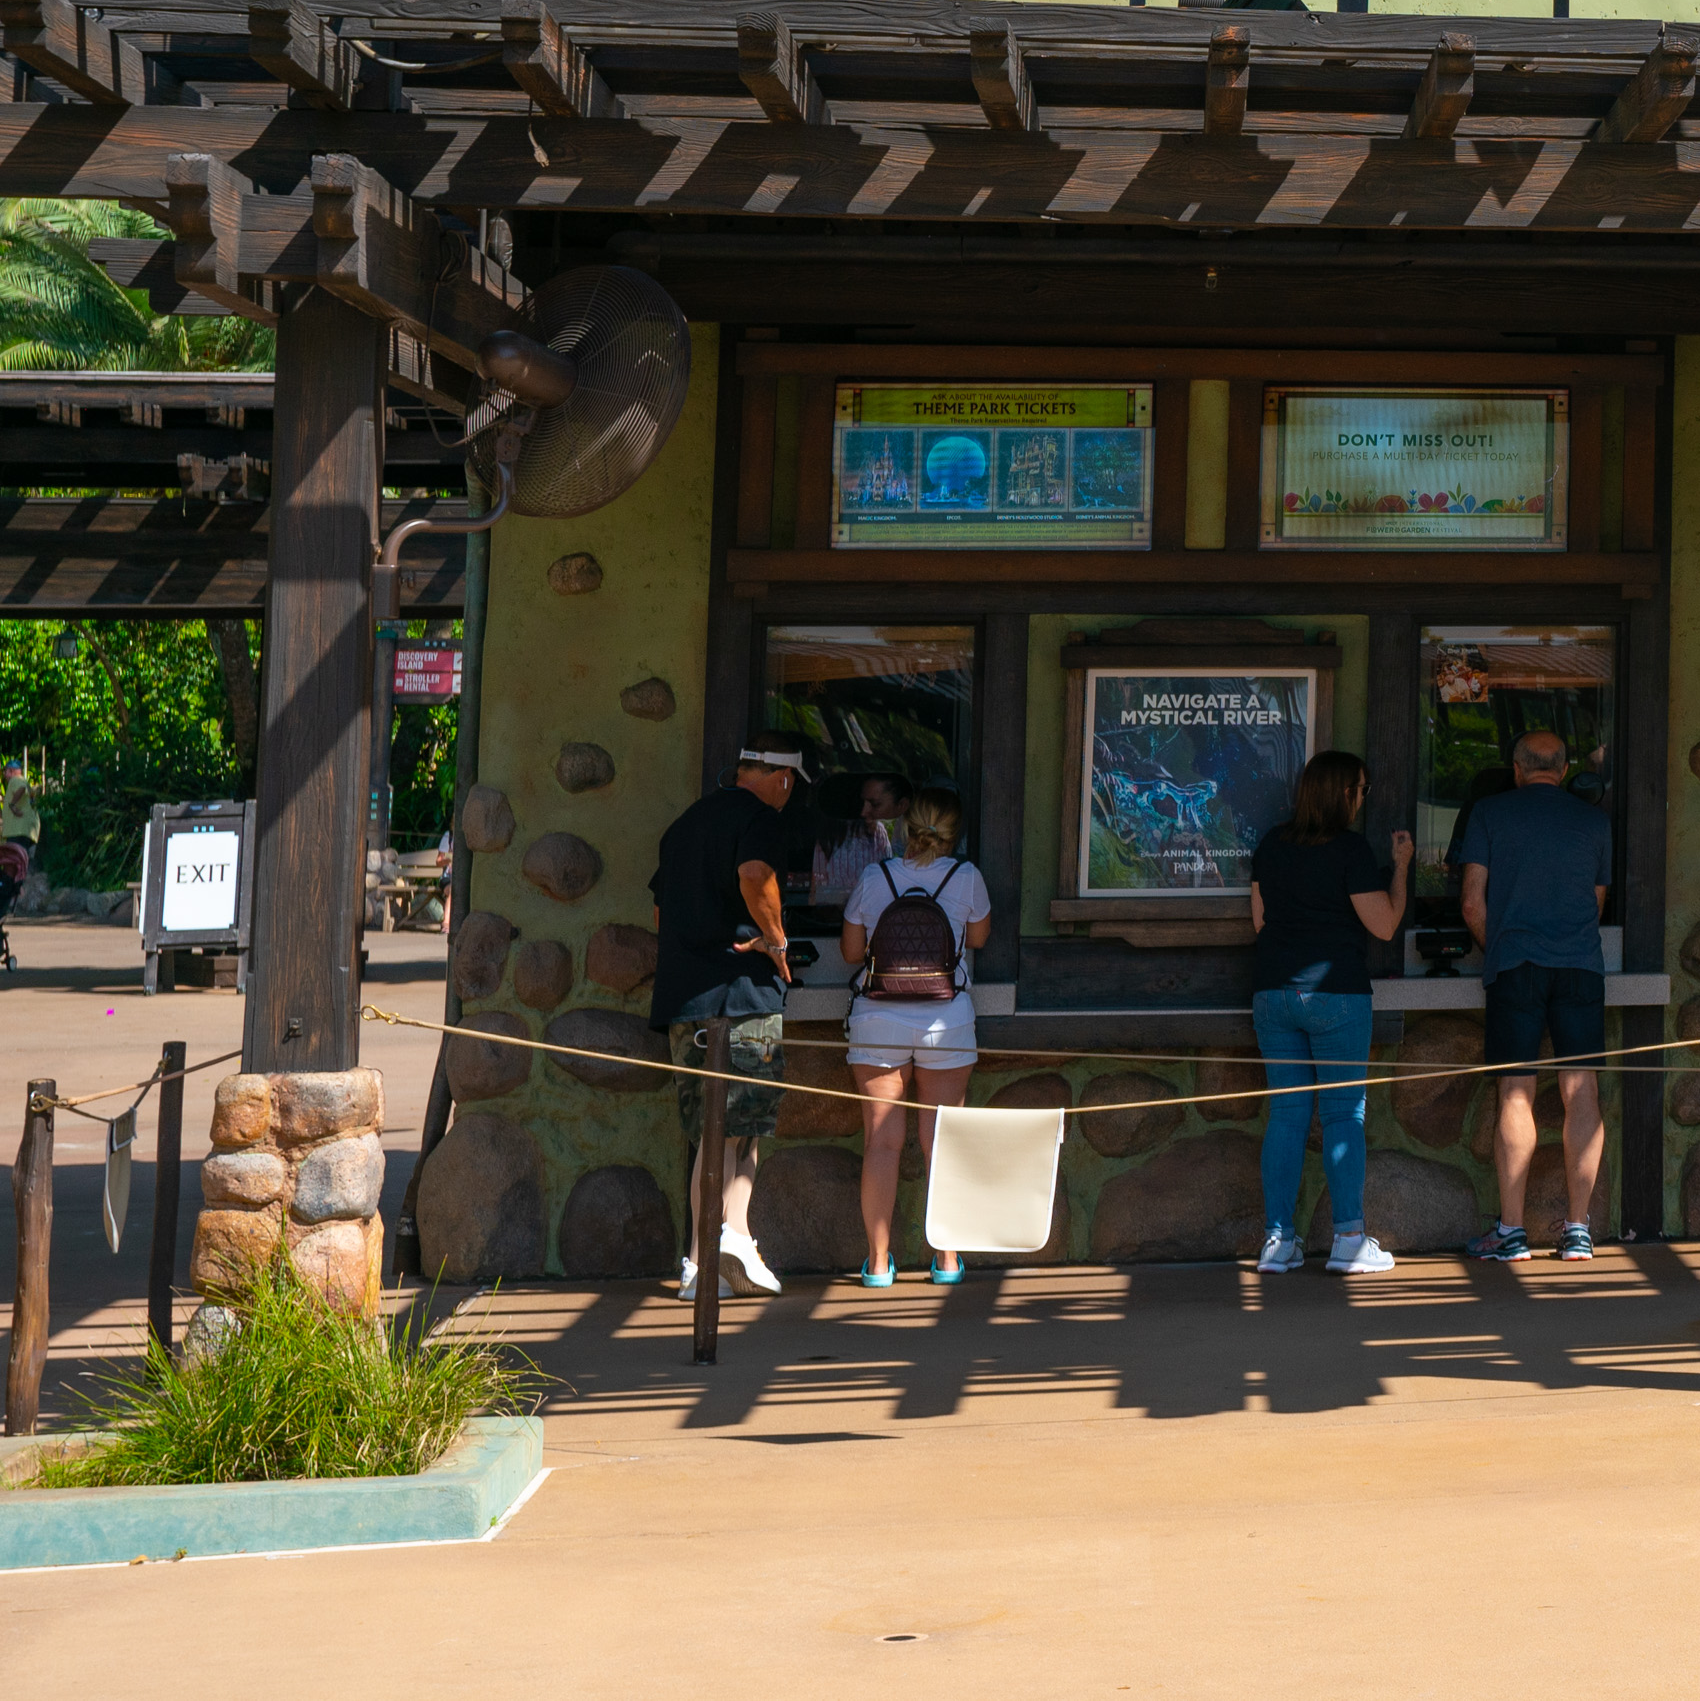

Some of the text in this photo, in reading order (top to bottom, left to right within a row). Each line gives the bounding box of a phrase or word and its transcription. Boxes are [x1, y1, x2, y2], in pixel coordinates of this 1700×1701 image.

[931, 393, 1058, 401] ASK ABOUT THE AVAILABILITY OF
[914, 403, 1076, 415] THEME PARK TICKETS
[1338, 434, 1493, 447] DON'T MISS OUT!
[1313, 452, 1519, 461] PURCHASE A MULTI-DAY TICKET TODAY
[398, 651, 438, 662] DISCOVERY
[397, 660, 424, 670] ISLAND
[404, 673, 440, 684] STROLLER
[404, 682, 430, 692] RENTAL
[1143, 694, 1261, 709] NAVIGATE A
[1120, 710, 1282, 725] MYSTICAL RIVER
[1162, 849, 1203, 858] ANIMAL
[1205, 849, 1251, 858] KINGDOM
[176, 863, 231, 884] EXIT
[1173, 862, 1218, 875] PANDORA
